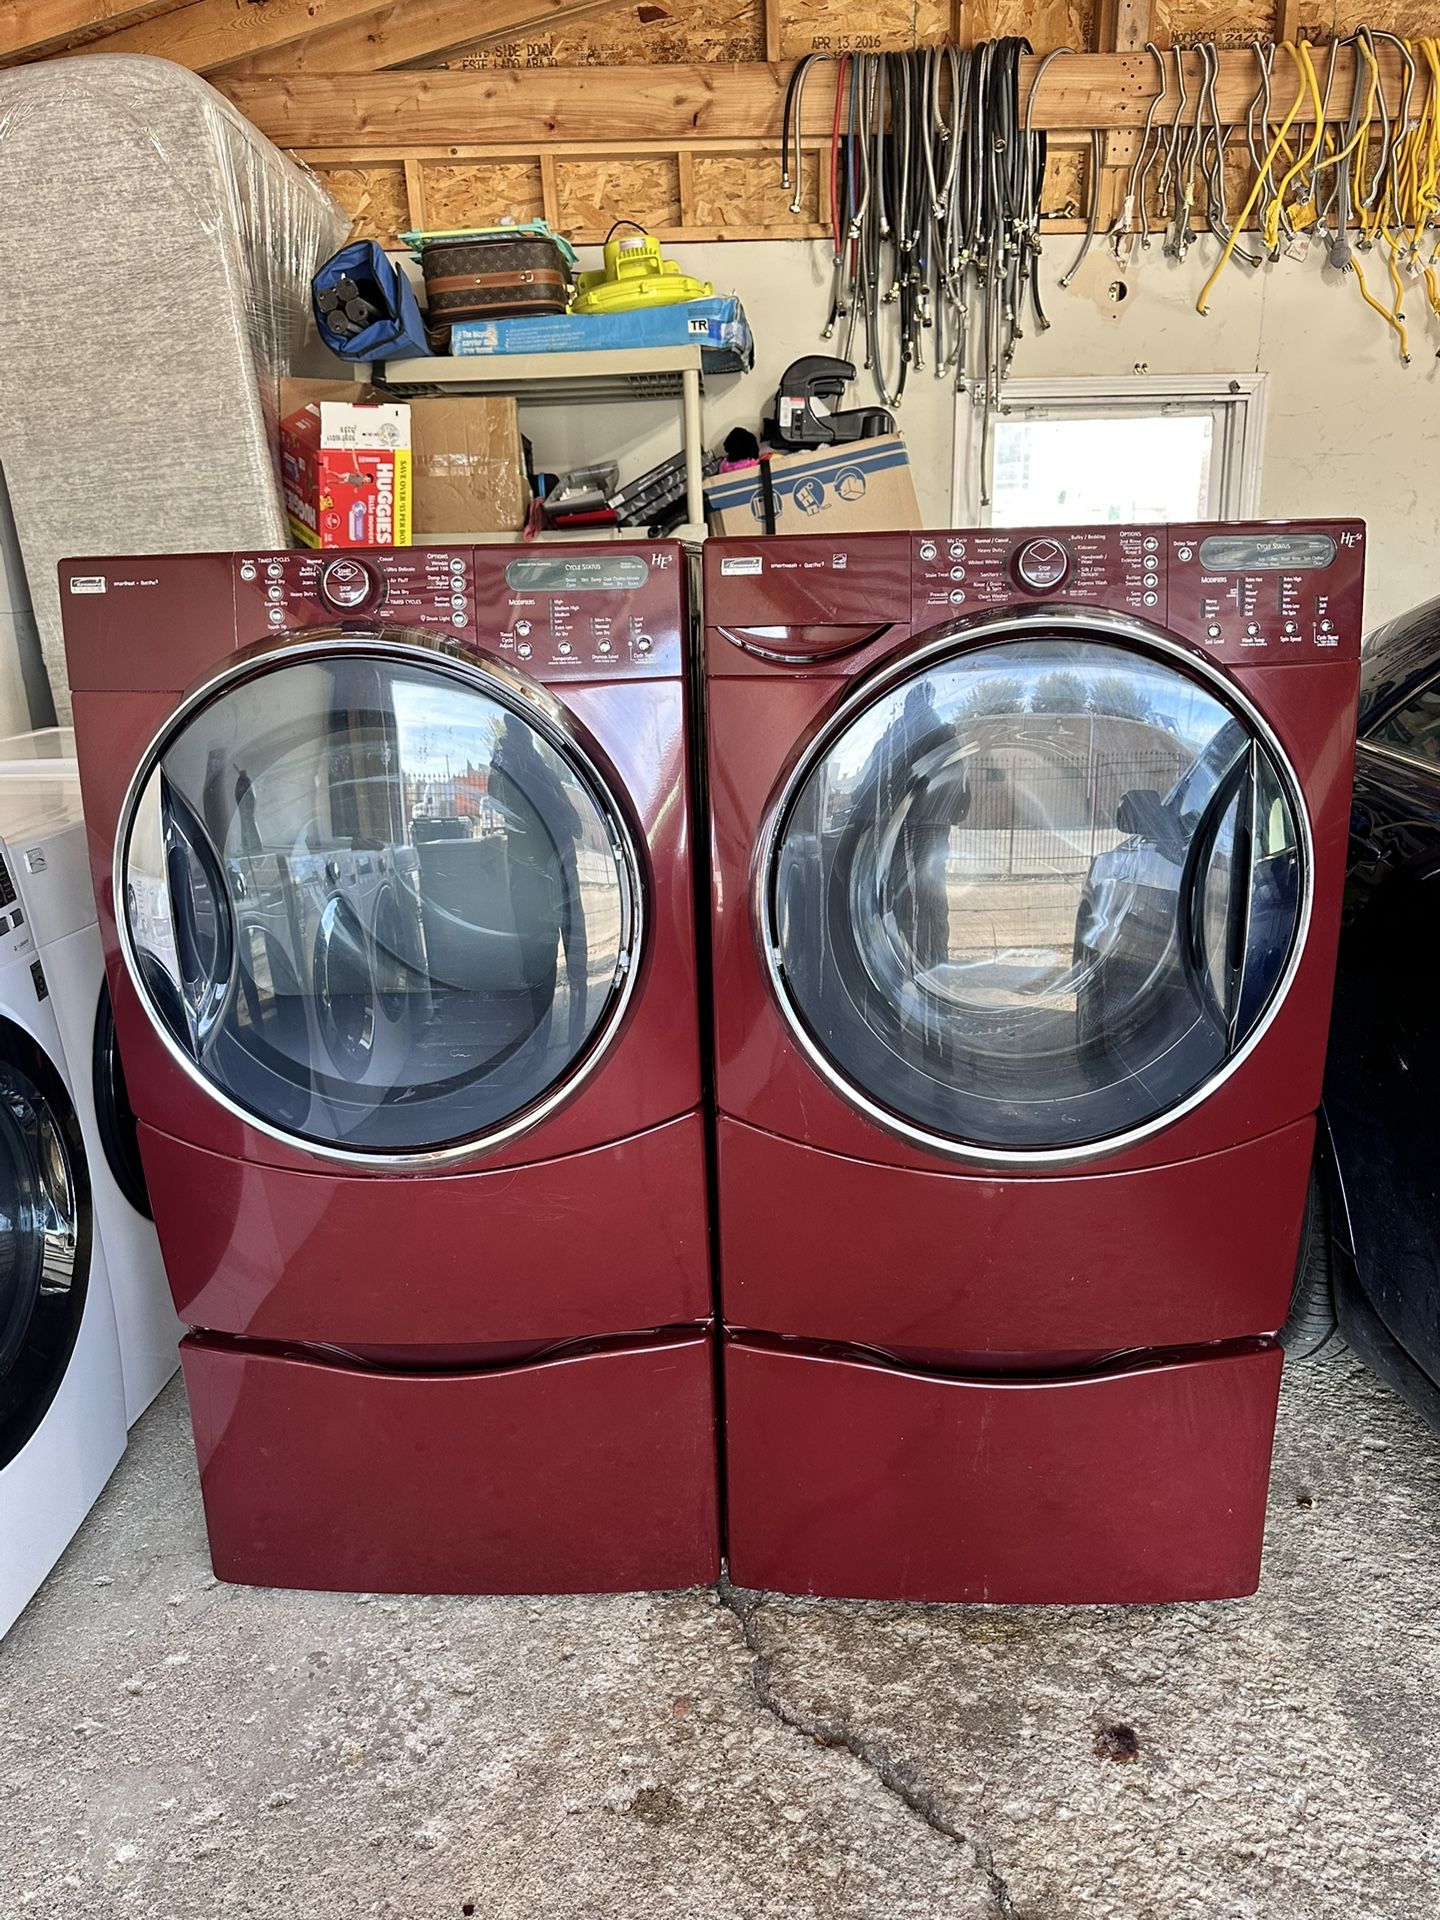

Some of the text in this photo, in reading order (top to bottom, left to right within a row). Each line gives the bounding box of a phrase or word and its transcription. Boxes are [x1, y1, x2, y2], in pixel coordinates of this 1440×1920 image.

[811, 34, 882, 49] APR 13 2016
[495, 44, 521, 58] SIDE
[526, 43, 553, 57] DOWN
[690, 320, 708, 331] TR
[376, 463, 394, 544] HUGGIES
[1256, 542, 1291, 551] CYCLE STATUS
